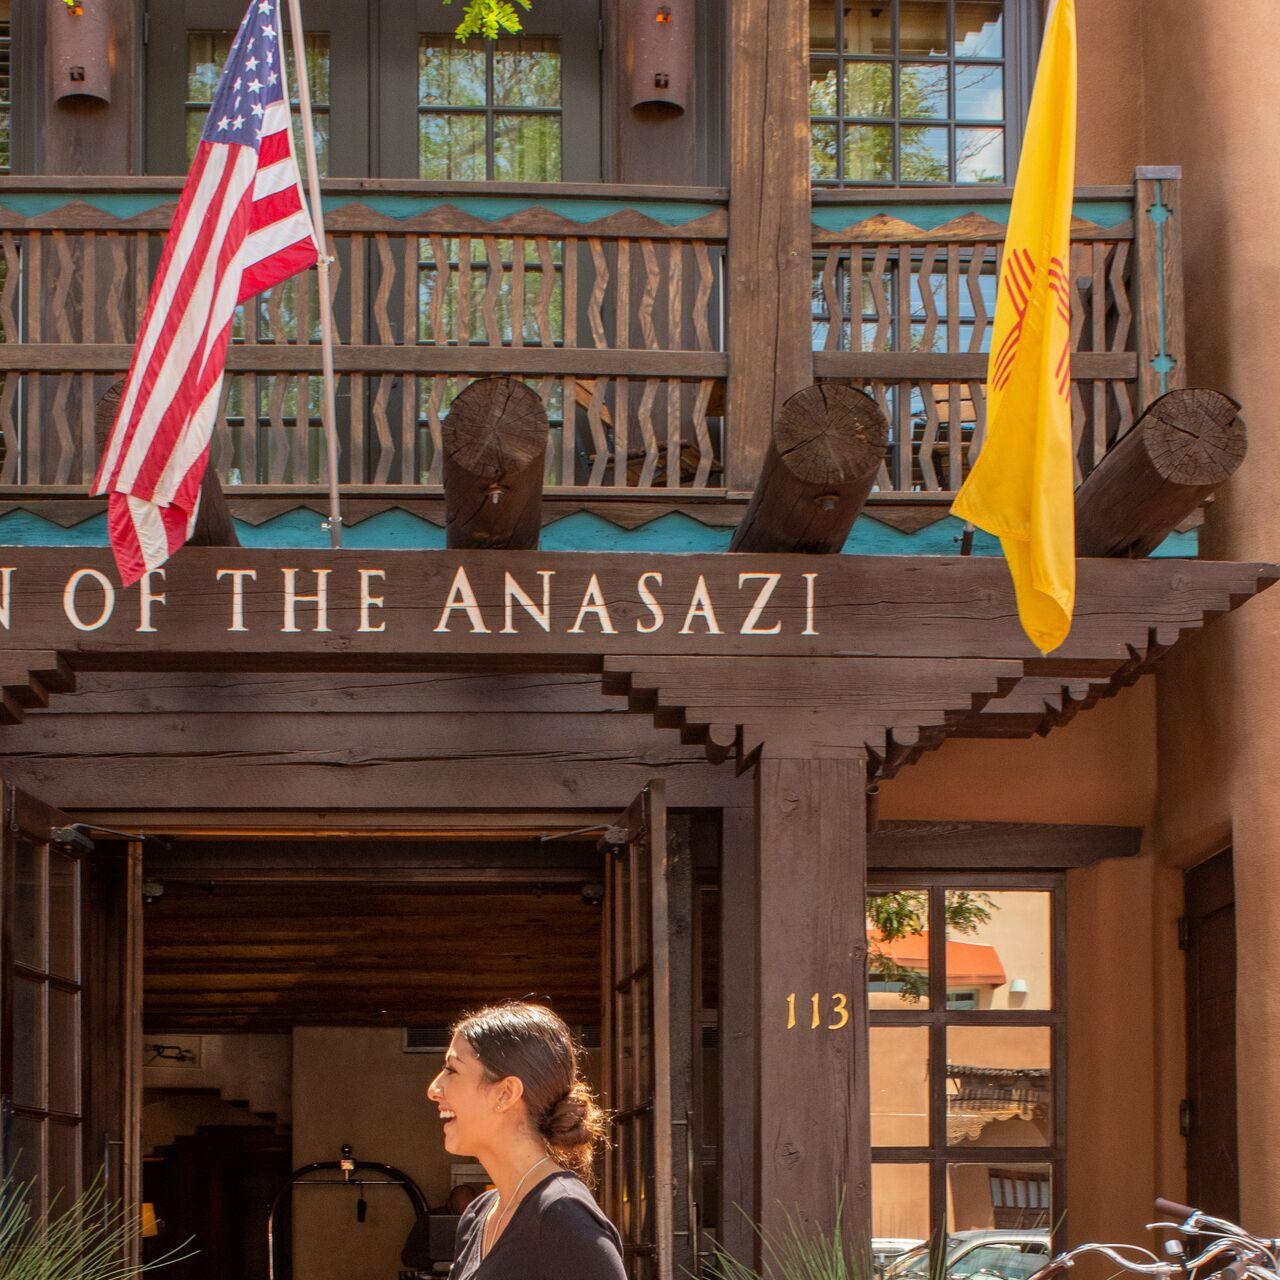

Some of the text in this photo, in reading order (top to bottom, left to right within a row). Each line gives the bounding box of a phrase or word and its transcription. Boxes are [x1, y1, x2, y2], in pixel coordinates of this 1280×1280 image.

[62, 567, 167, 632] OF
[215, 568, 387, 632] THE
[433, 565, 819, 636] ANASAZI
[786, 992, 849, 1030] 113
